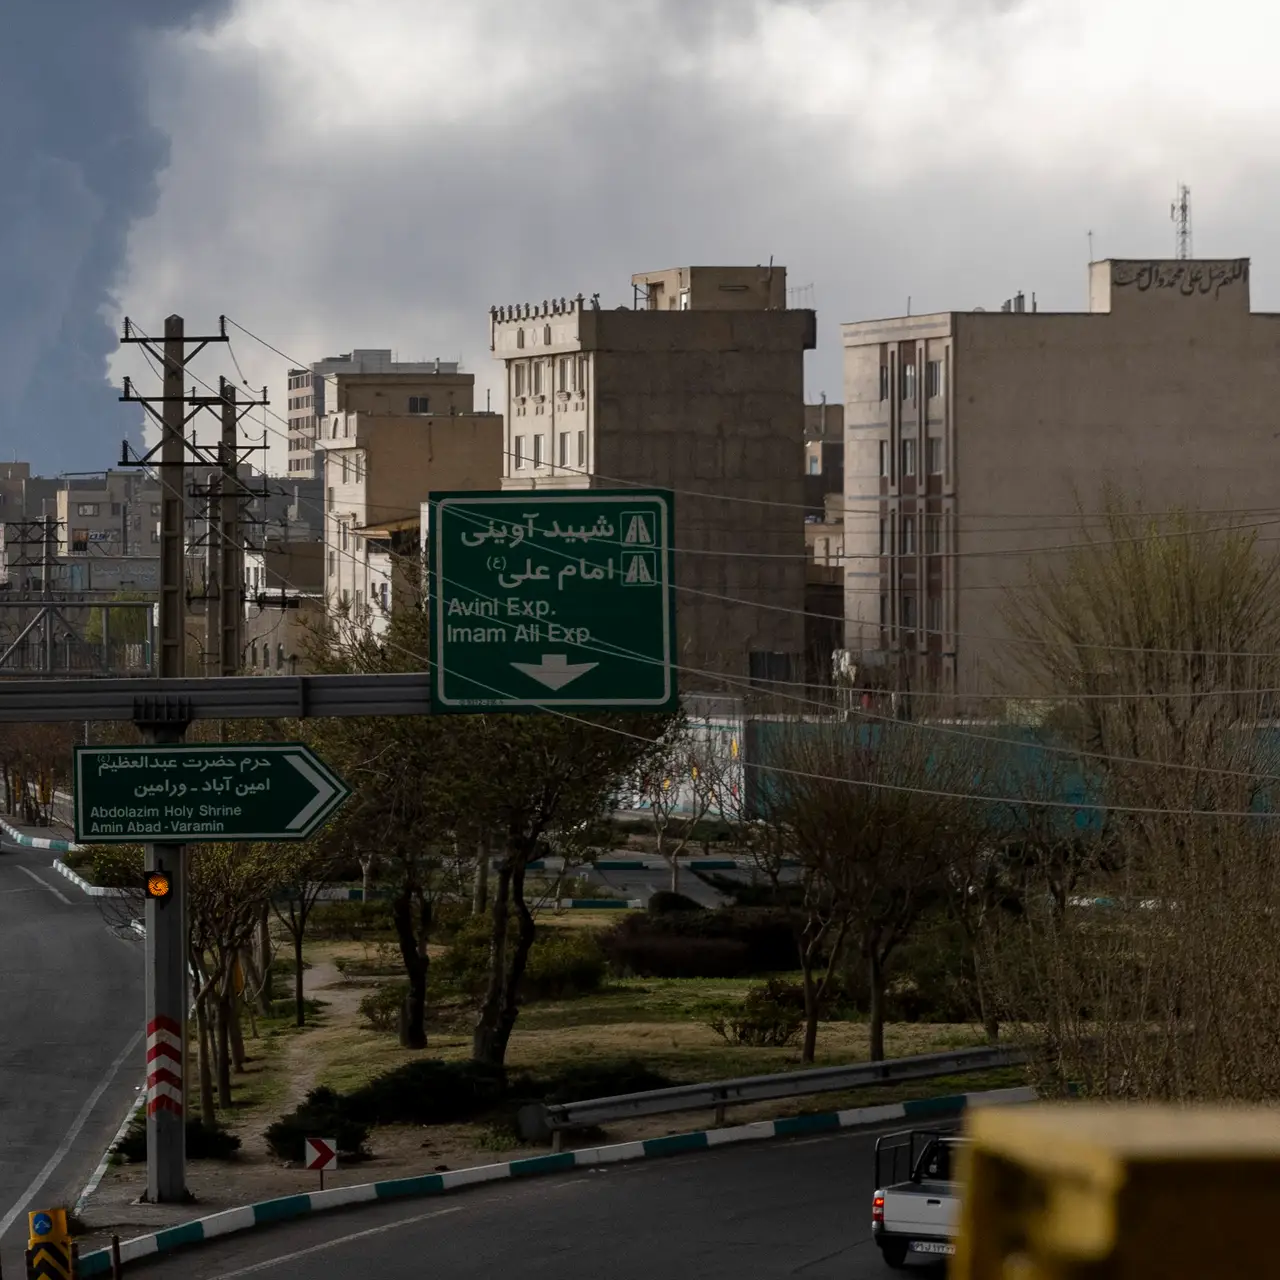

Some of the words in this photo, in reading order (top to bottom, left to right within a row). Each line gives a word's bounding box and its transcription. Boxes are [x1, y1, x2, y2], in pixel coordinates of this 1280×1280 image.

[461, 513, 539, 548] آوینی
[542, 516, 614, 544] شهید
[558, 558, 613, 590] امام
[507, 597, 556, 620] Exp.
[447, 624, 506, 642] Imam
[514, 624, 540, 642] Ali
[182, 756, 237, 773] حضرت
[240, 757, 272, 773] حرم
[134, 780, 188, 797] ورامین
[201, 776, 233, 796] آباد
[235, 778, 270, 797] امین
[90, 806, 160, 818] Abdolazim
[165, 805, 194, 819] Holy
[199, 805, 242, 817] Shrine
[90, 822, 124, 833] Amin
[170, 821, 224, 832] Varamin
